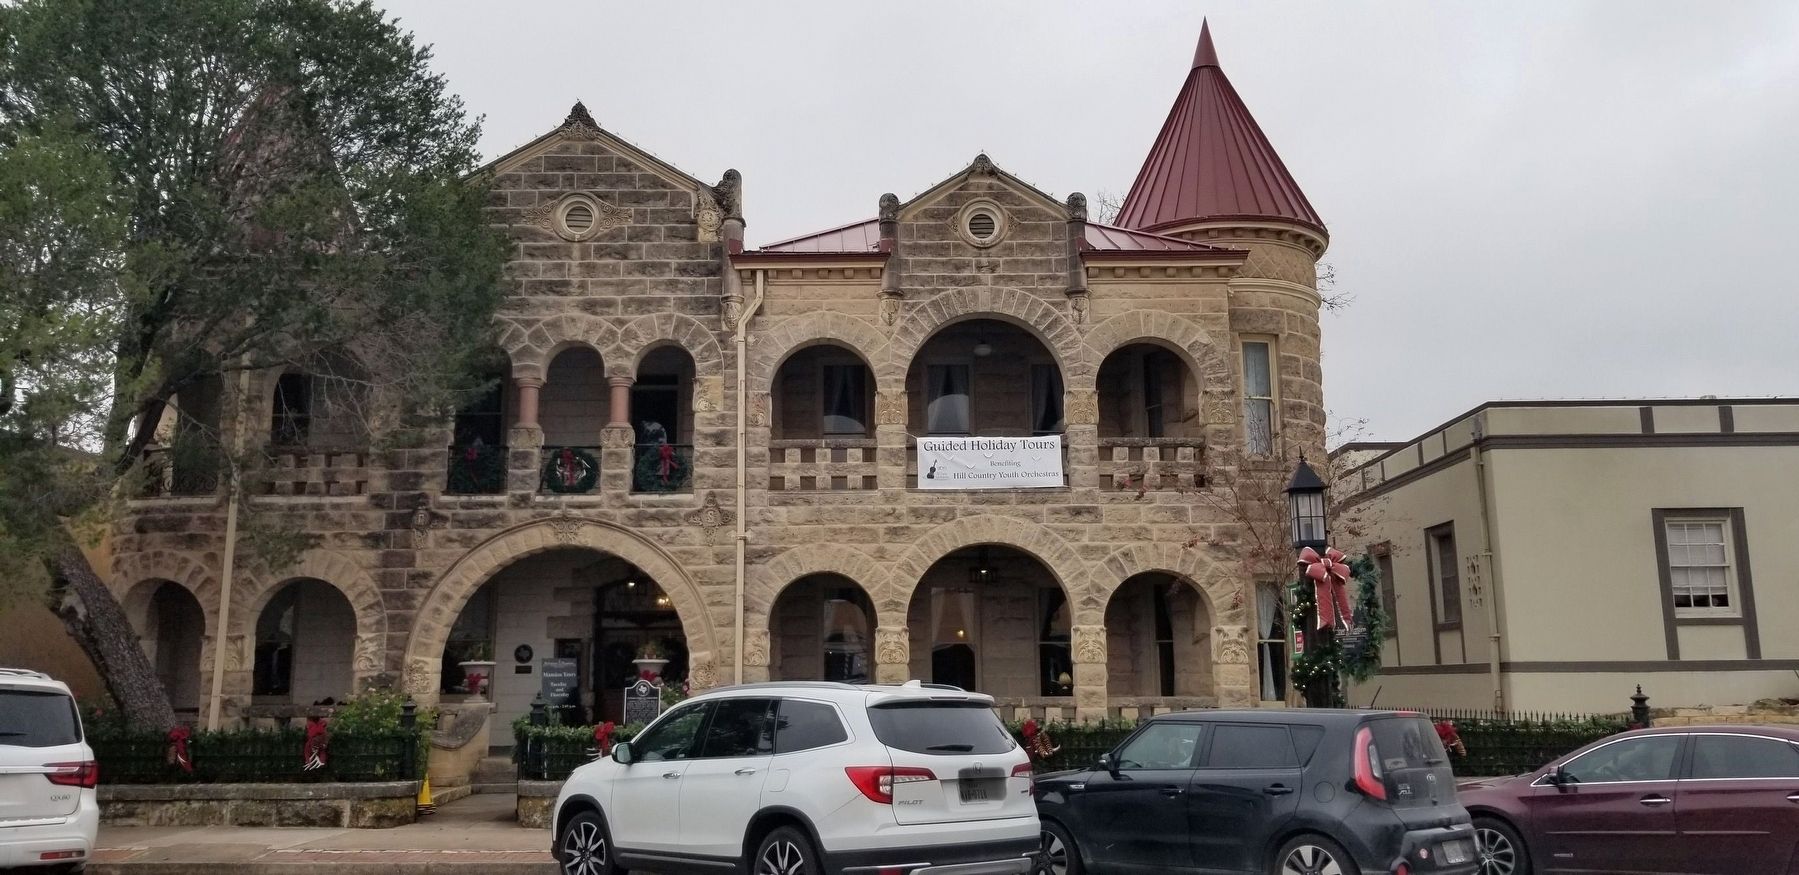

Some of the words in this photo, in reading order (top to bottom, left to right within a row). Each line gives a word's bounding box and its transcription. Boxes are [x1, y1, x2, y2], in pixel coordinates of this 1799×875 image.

[923, 440, 967, 452] Guided
[971, 440, 1017, 452] Holiday
[1020, 439, 1055, 450] Tours
[953, 471, 966, 479] Hill
[968, 471, 997, 480] Country
[998, 470, 1019, 478] Youth
[1021, 470, 1059, 478] Orchestras
